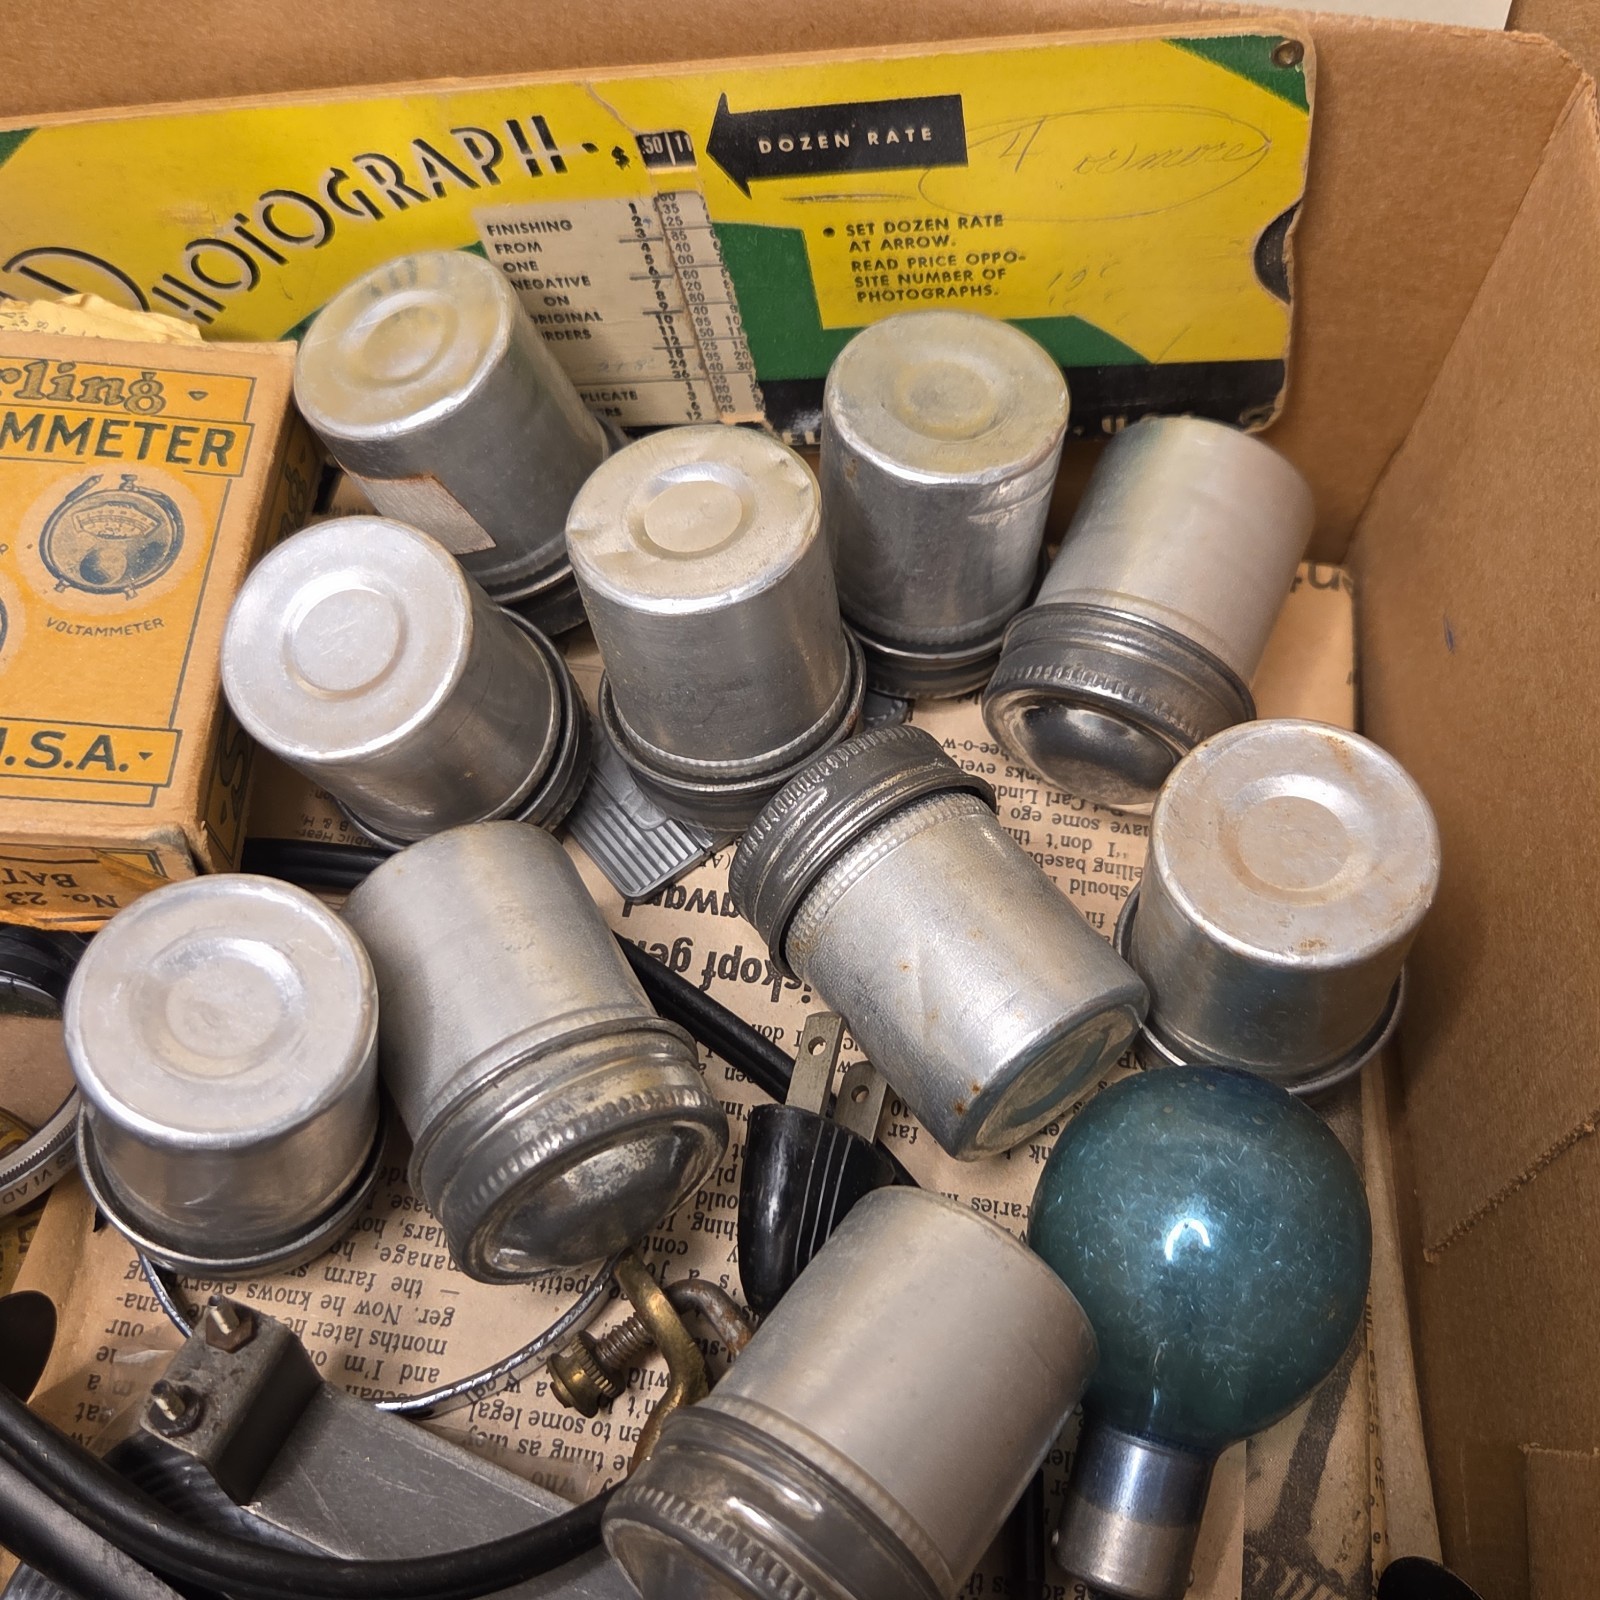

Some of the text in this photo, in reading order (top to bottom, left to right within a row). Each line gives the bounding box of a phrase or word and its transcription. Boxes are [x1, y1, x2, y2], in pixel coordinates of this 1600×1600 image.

[757, 127, 933, 154] DOZEN RATE
[486, 219, 574, 236] FINISHING
[845, 214, 1005, 237] SET DOZEN RATE
[494, 241, 543, 255] FROM
[849, 234, 957, 254] AT ARROW.
[502, 260, 539, 274] ONE
[851, 250, 1026, 273] READ PRICE OPPO-
[511, 274, 591, 291] NEGATIVE
[855, 267, 1007, 289] SITE NUMBER OF
[543, 295, 571, 307] ON
[856, 284, 999, 303] PHOTOGRAPHS.
[45, 615, 165, 638] VOLTAMMETER
[0, 727, 130, 773] .S.A.
[1010, 805, 1042, 823] ego
[1051, 813, 1100, 831] some
[1045, 832, 1093, 854] don't
[5, 891, 121, 909] No. 23
[1069, 878, 1130, 900] should
[888, 1123, 919, 1145] far
[324, 1266, 378, 1294] farm
[391, 1276, 424, 1299] the
[246, 1283, 313, 1311] knows
[320, 1294, 347, 1317] he
[353, 1299, 403, 1326] Now
[414, 1305, 456, 1329] ger.
[312, 1321, 365, 1348] later
[369, 1329, 448, 1357] months
[344, 1354, 385, 1382] I'm
[399, 1363, 440, 1386] and
[468, 1398, 524, 1430] legal
[528, 1409, 587, 1437] some
[591, 1420, 612, 1444] to
[517, 1438, 542, 1458] as
